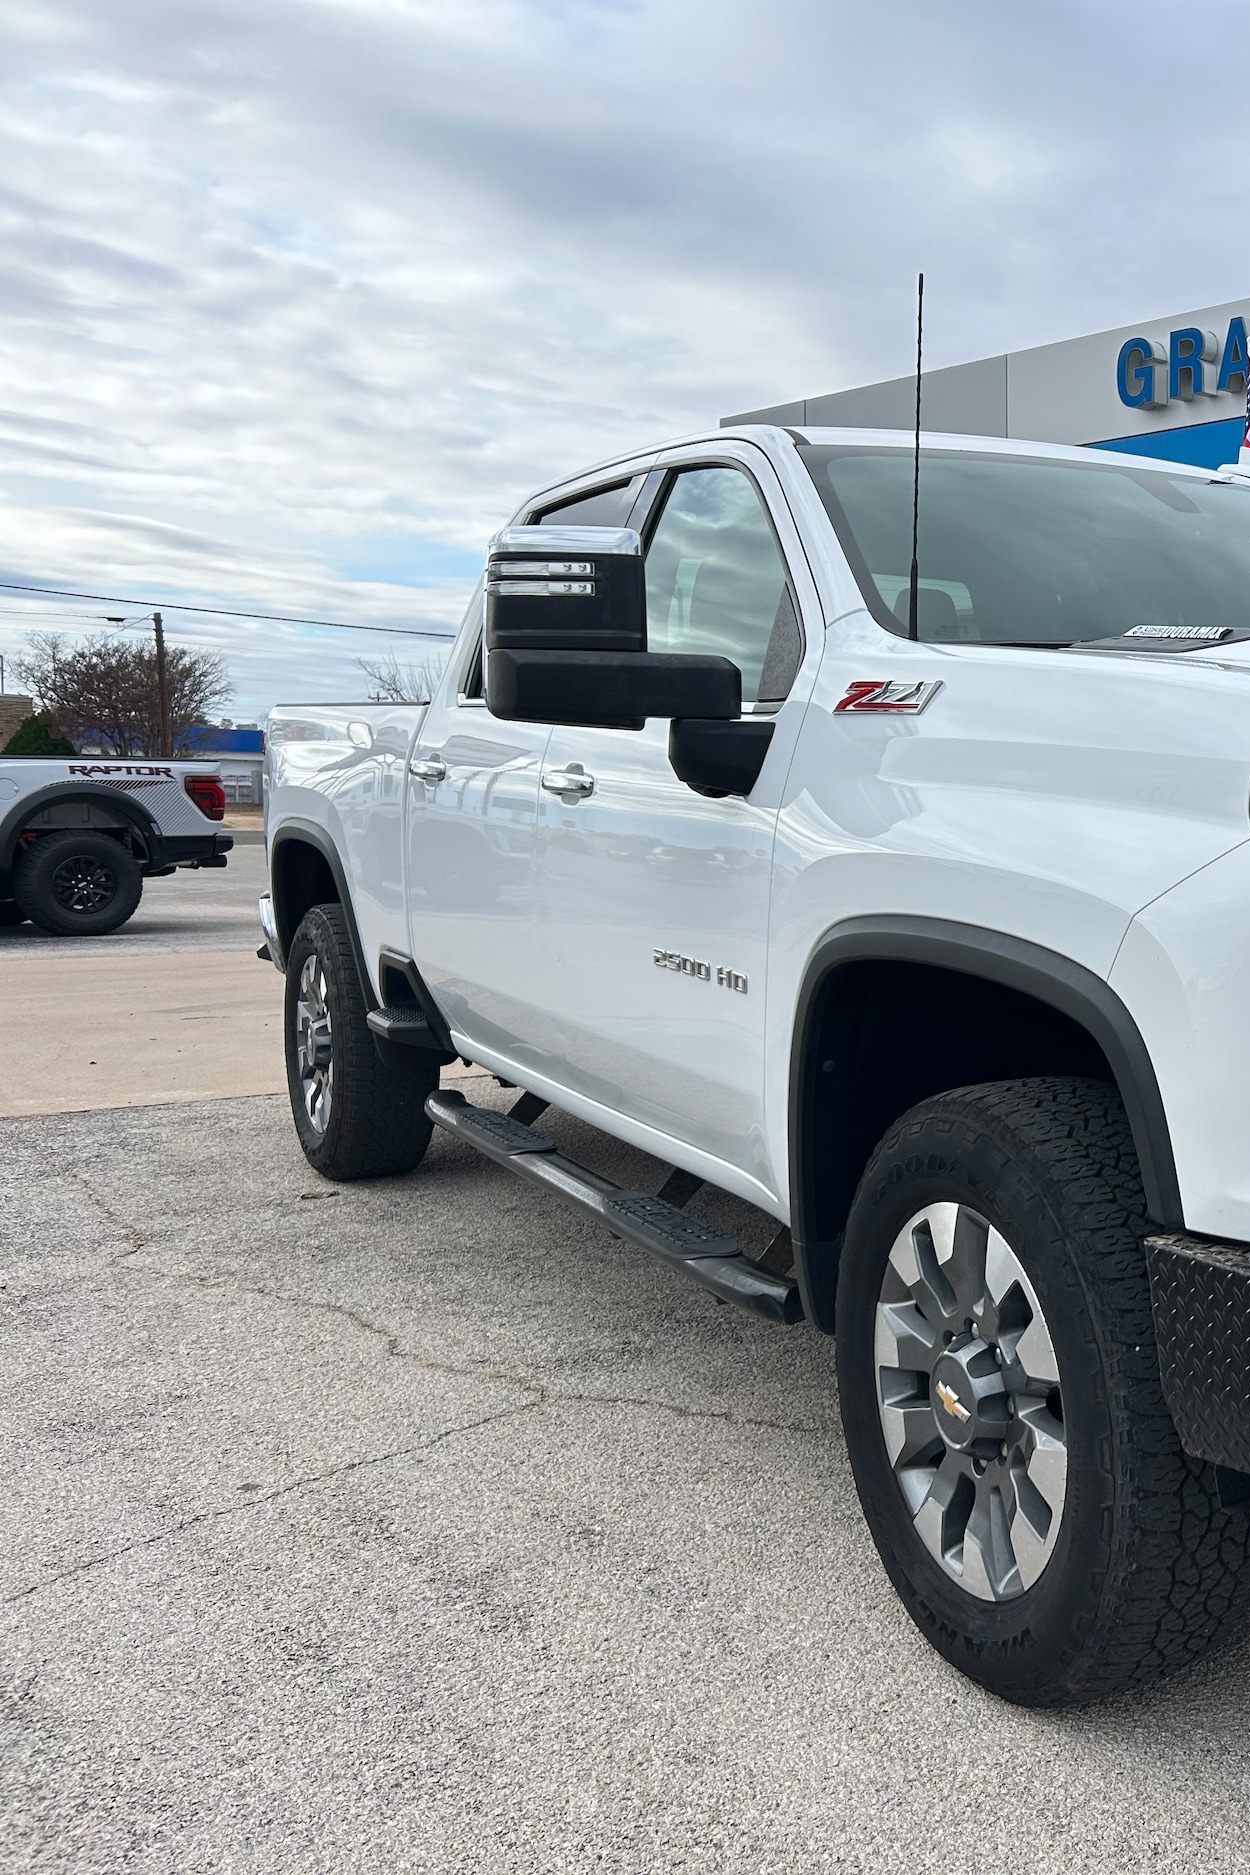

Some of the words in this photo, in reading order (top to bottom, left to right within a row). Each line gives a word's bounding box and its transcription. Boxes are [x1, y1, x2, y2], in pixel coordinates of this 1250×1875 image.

[1162, 625, 1228, 640] DURAMAX
[832, 680, 944, 716] Z71
[68, 765, 177, 780] RAPTOR
[652, 946, 711, 982] 2500
[716, 965, 749, 994] HD
